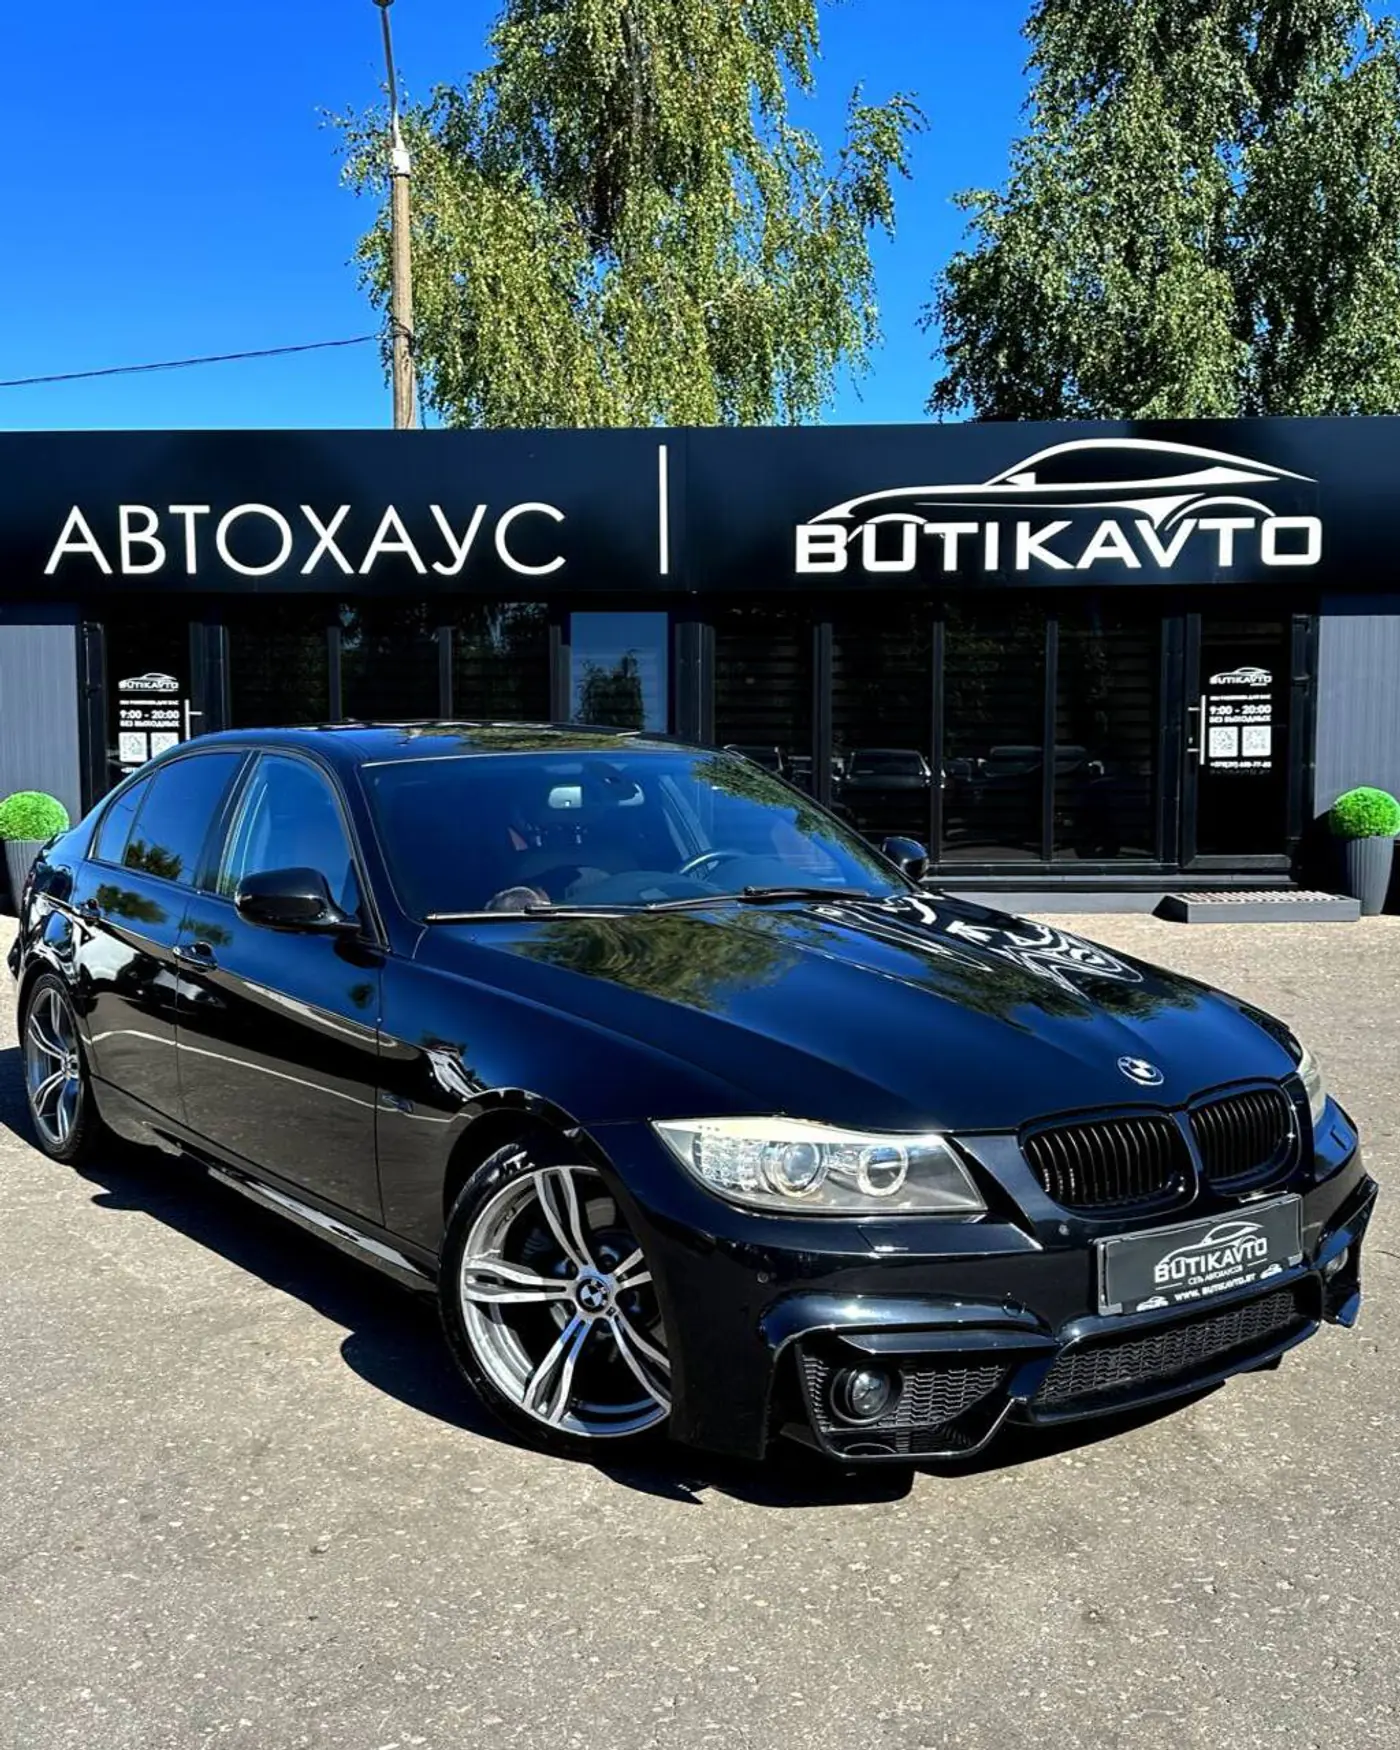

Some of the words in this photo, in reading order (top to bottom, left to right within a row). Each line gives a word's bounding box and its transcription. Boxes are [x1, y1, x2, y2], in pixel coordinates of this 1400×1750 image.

[44, 502, 566, 576] АВТОХАУС
[795, 515, 1322, 573] BUTIKAVTO
[1209, 676, 1272, 684] BUTIKAVTO
[120, 710, 142, 719] 9:00
[151, 710, 179, 719] 20:00
[1209, 705, 1233, 715] 9:00
[1241, 704, 1272, 715] 20:00
[1154, 1237, 1267, 1283] BUTIKAVTO
